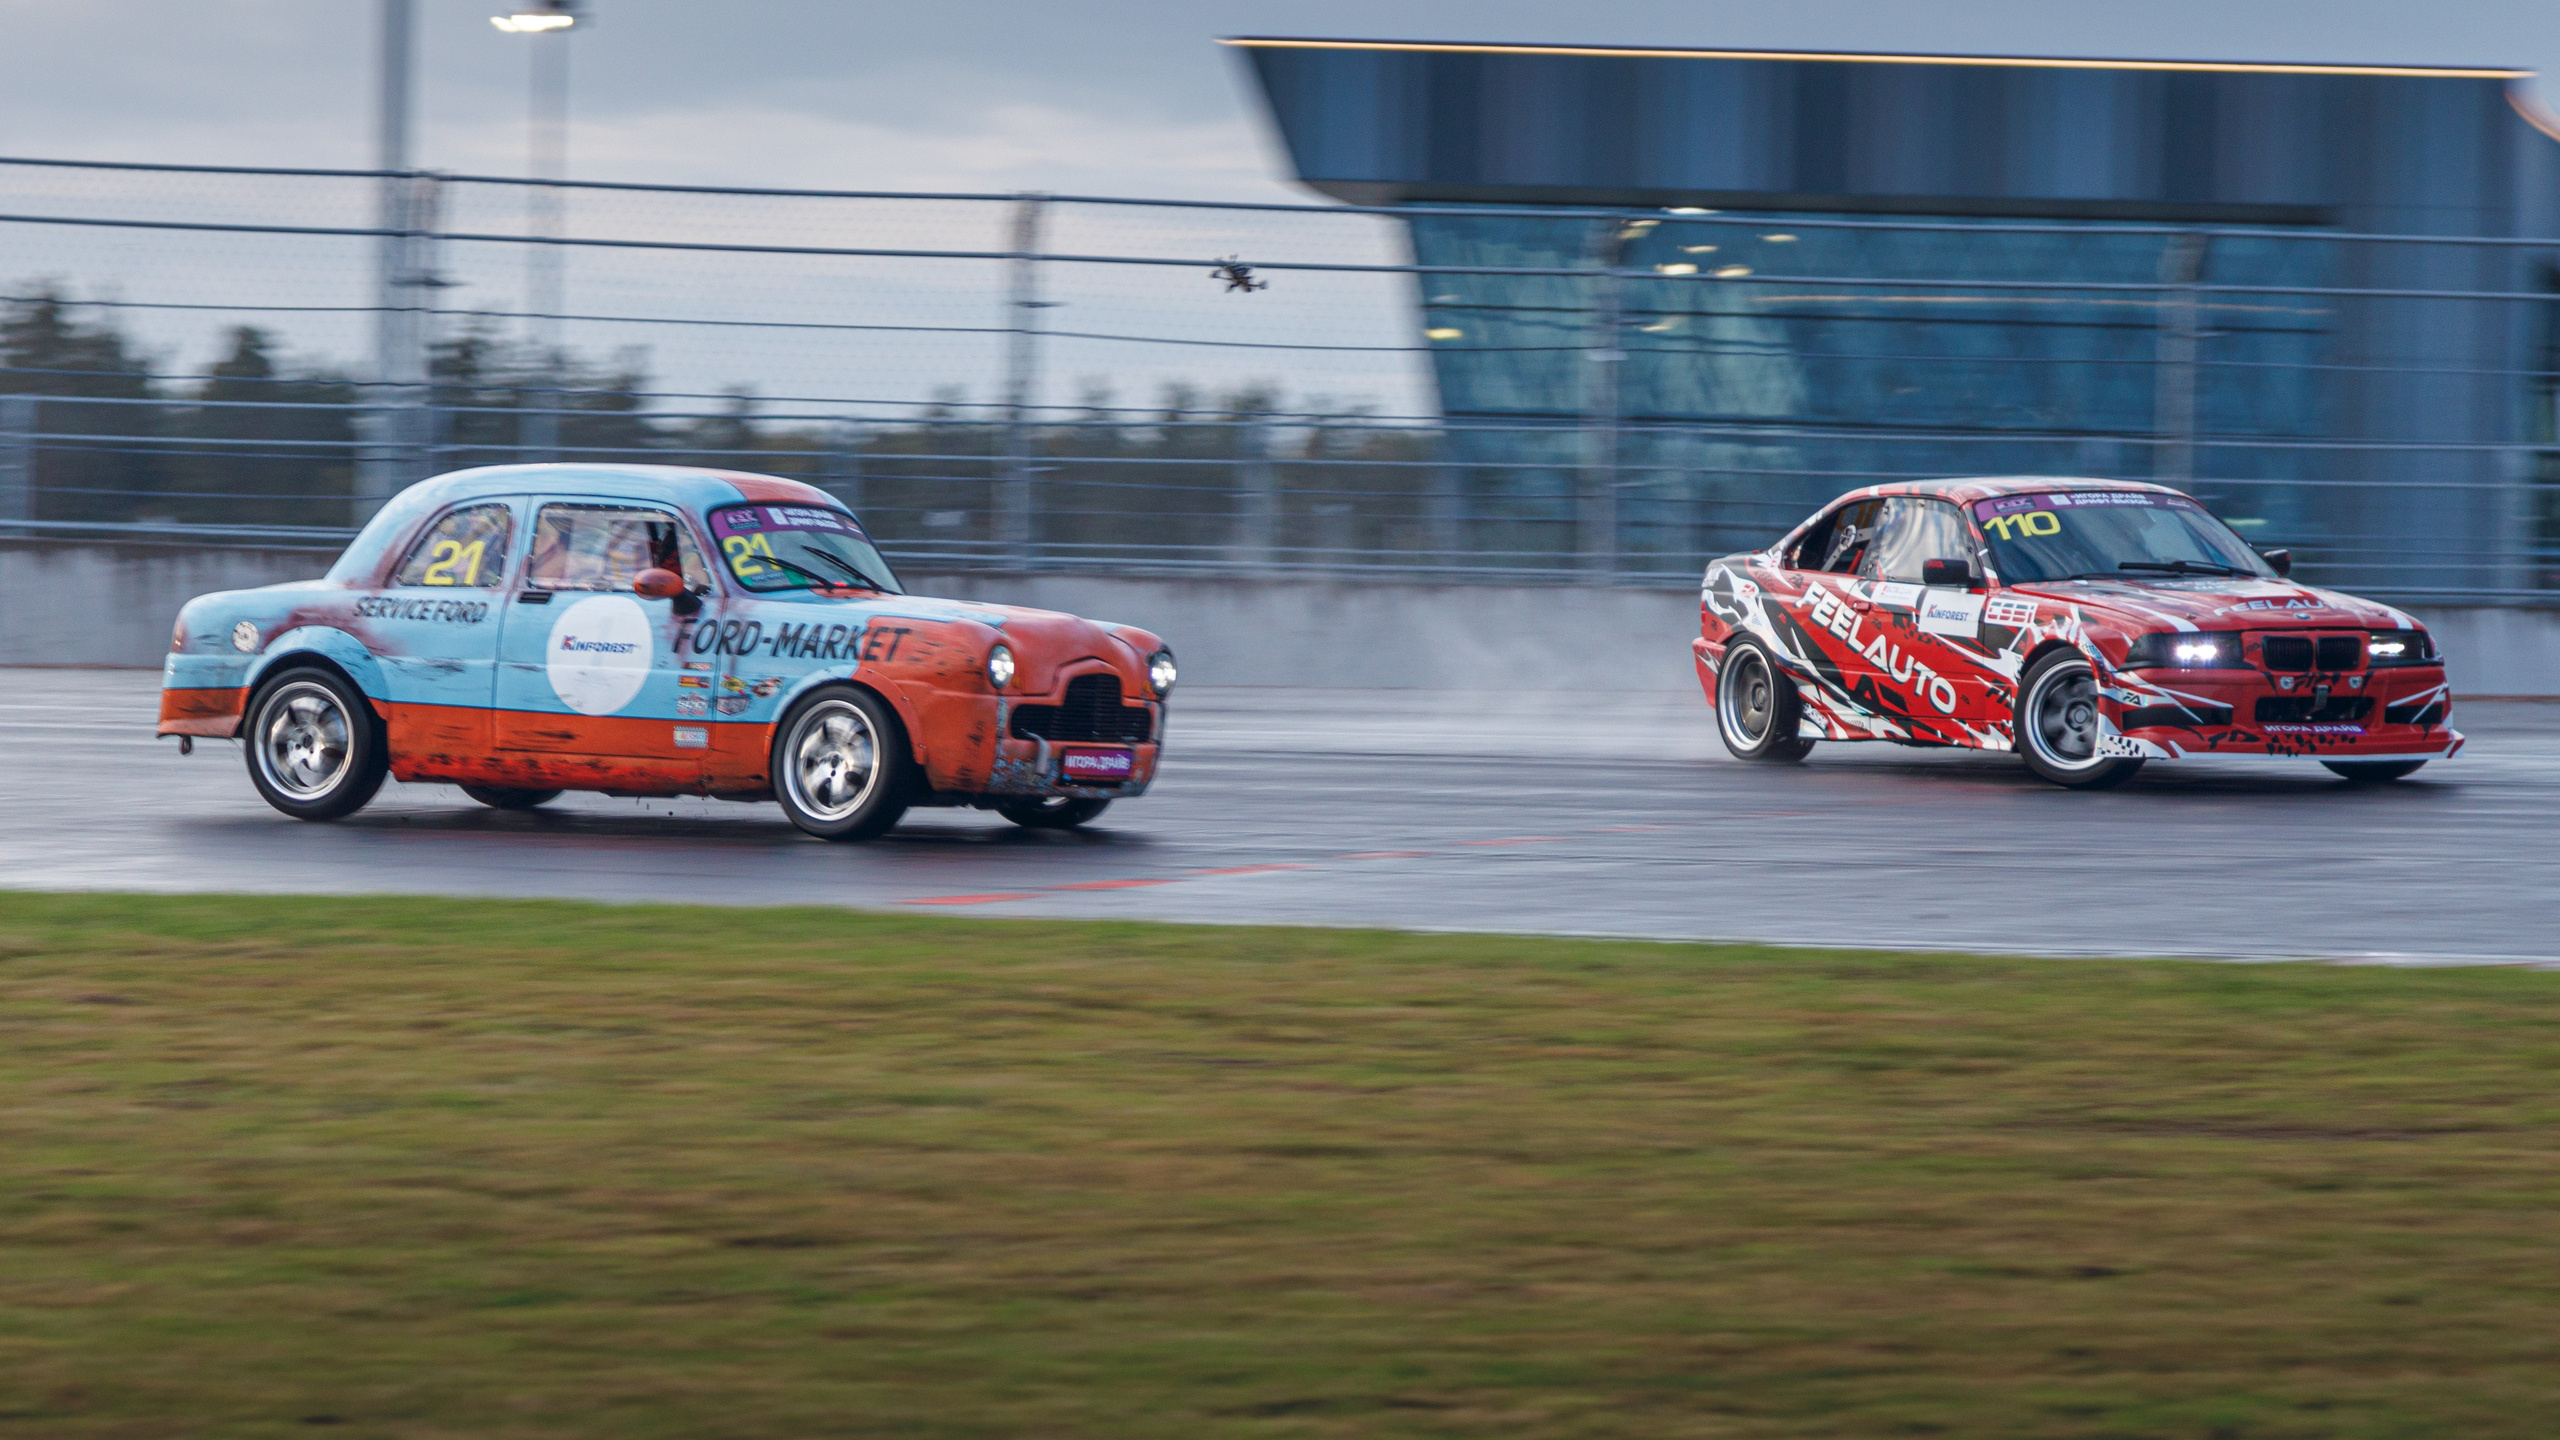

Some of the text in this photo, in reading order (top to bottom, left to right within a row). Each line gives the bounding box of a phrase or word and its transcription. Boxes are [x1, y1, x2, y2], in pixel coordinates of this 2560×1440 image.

[1984, 511, 2062, 541] 110
[423, 540, 486, 586] 21
[723, 532, 782, 578] 21
[352, 596, 489, 623] SERVICE FORD
[672, 618, 910, 661] FORD-MARKET
[1793, 580, 1957, 715] FEELAUTO
[2264, 724, 2362, 734] ИГОРА ДРАЙВ
